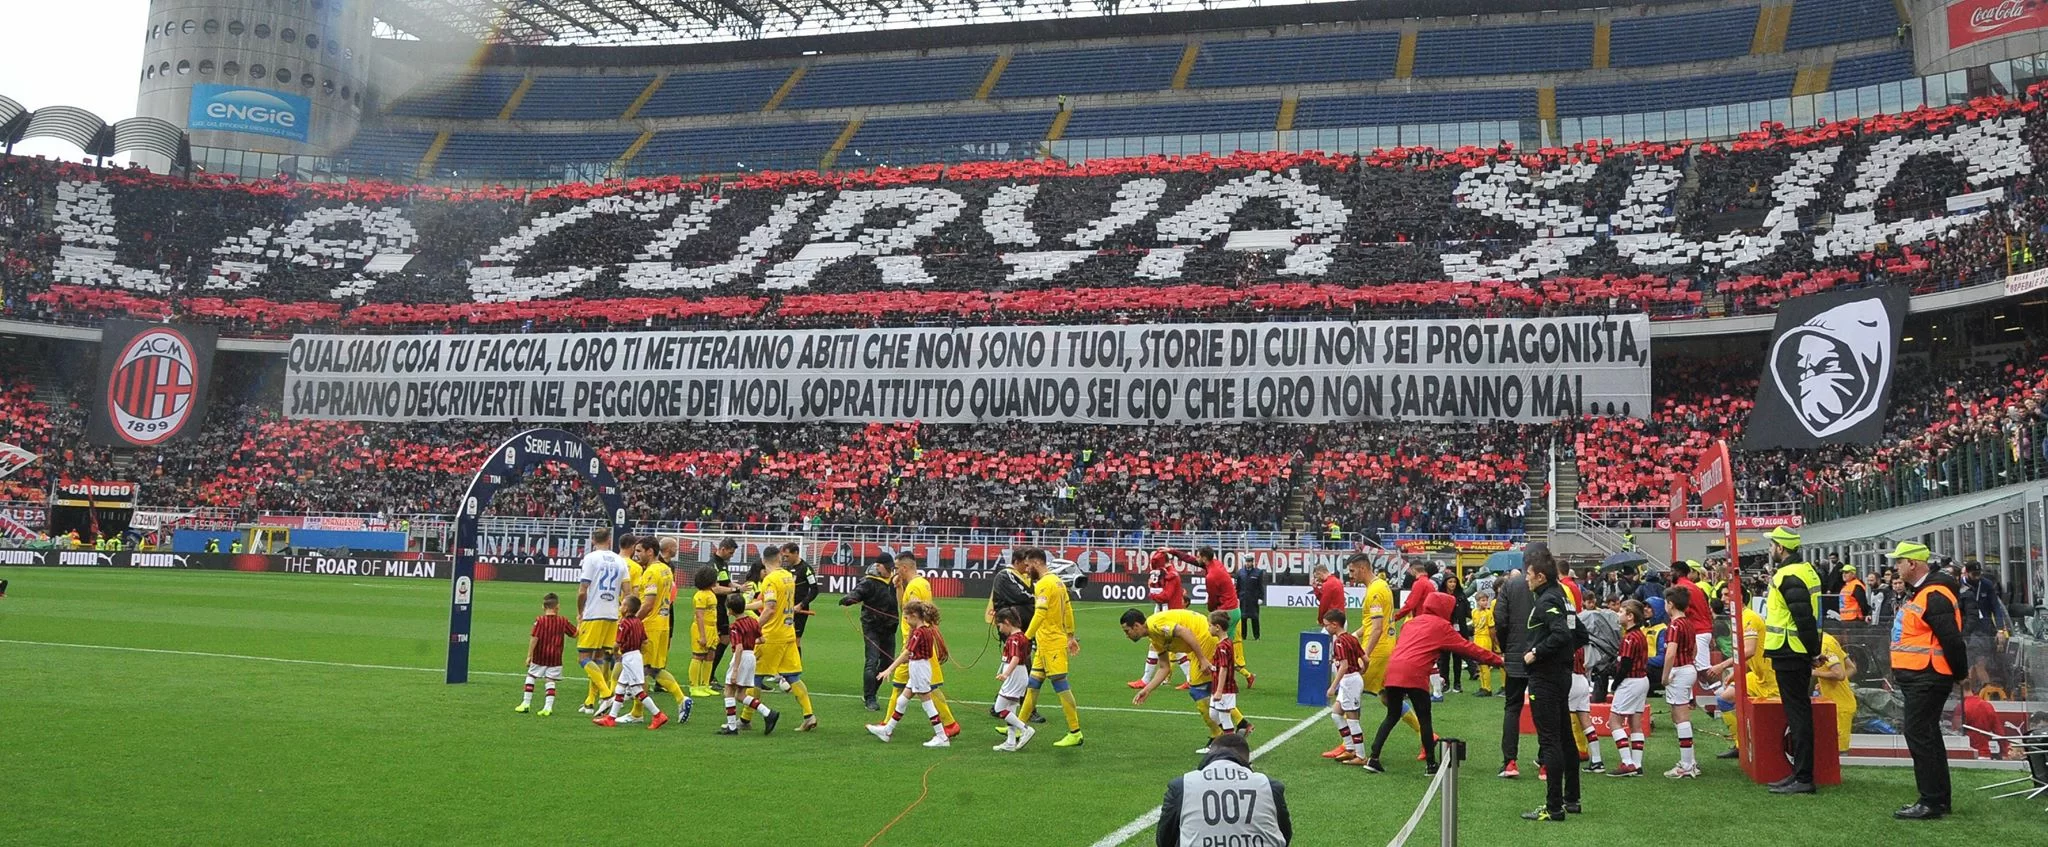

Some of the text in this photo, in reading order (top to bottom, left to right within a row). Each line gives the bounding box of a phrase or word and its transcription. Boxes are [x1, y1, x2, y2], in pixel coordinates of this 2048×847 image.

[467, 169, 1352, 302] CURVA
[1440, 116, 2034, 283] SUD
[135, 338, 183, 360] ACM
[288, 319, 1648, 375] QUALSIASI COSA TU FACCIA, LORO TI METTERANNO ABITI CHE NON SONO I TUOI, STORIE DI CUI NON SEI PROTAGONISTA,
[290, 379, 401, 417] SAPRANNO
[404, 380, 525, 417] DESCRIVERTI
[530, 380, 567, 417] NEL
[572, 379, 683, 417] PEGGIORE
[687, 379, 723, 417] DEI
[727, 377, 795, 421] MODI,
[799, 377, 964, 418] SOPRATTUTTO
[969, 377, 1080, 420] QUANDO
[1086, 377, 1121, 419] SEI
[1127, 377, 1179, 420] CIO'
[1184, 377, 1235, 419] CHE
[1242, 375, 1315, 418] LORO
[1322, 374, 1384, 416] NON
[1389, 374, 1523, 417] SARANNO
[127, 420, 169, 433] 1899
[525, 435, 583, 459] SERIE A TIM
[490, 475, 501, 485] TIM
[69, 484, 130, 496] CARUGO
[605, 486, 616, 495] TIM
[1675, 520, 1702, 528] ALGIDA
[1765, 518, 1788, 526] ALGIDA
[59, 551, 98, 565] PUMA
[464, 548, 474, 557] TIM
[131, 553, 174, 567] PUMA
[283, 557, 436, 578] THE ROAR OF MILAN
[598, 561, 618, 591] 22
[1103, 585, 1146, 600] 00:00
[457, 634, 468, 643] TIM
[1203, 768, 1249, 780] CLUB
[1202, 789, 1257, 826] 007
[1203, 834, 1264, 847] PHOTO
